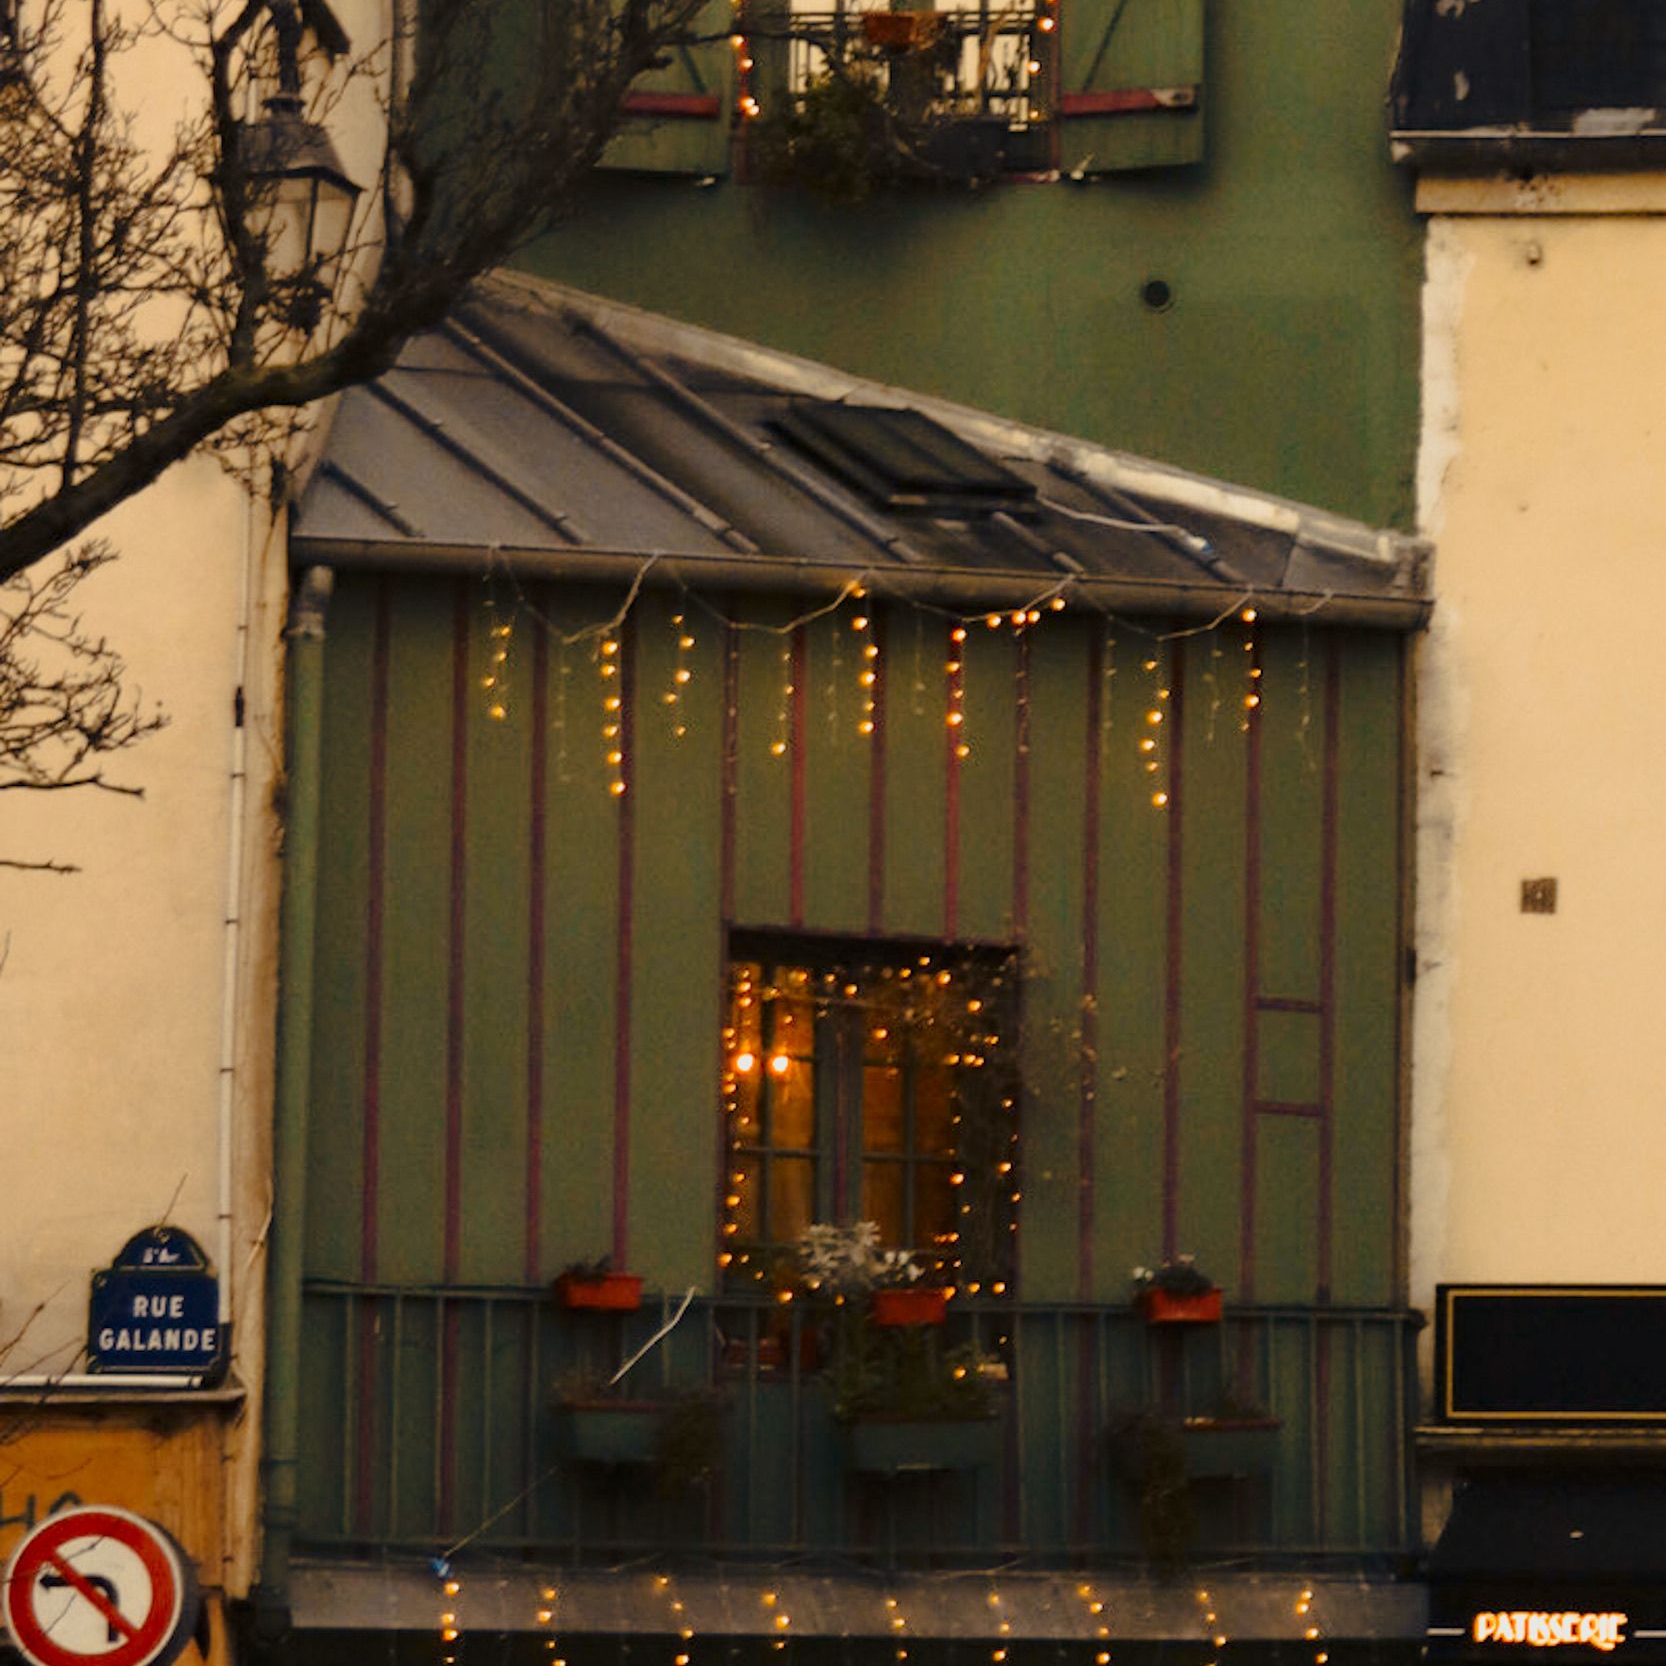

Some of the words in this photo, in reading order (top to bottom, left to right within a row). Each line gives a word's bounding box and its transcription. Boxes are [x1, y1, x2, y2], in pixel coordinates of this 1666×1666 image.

[133, 1295, 184, 1319] RUE
[99, 1327, 216, 1352] GALANDE
[1473, 1611, 1628, 1652] PATISSERIE
